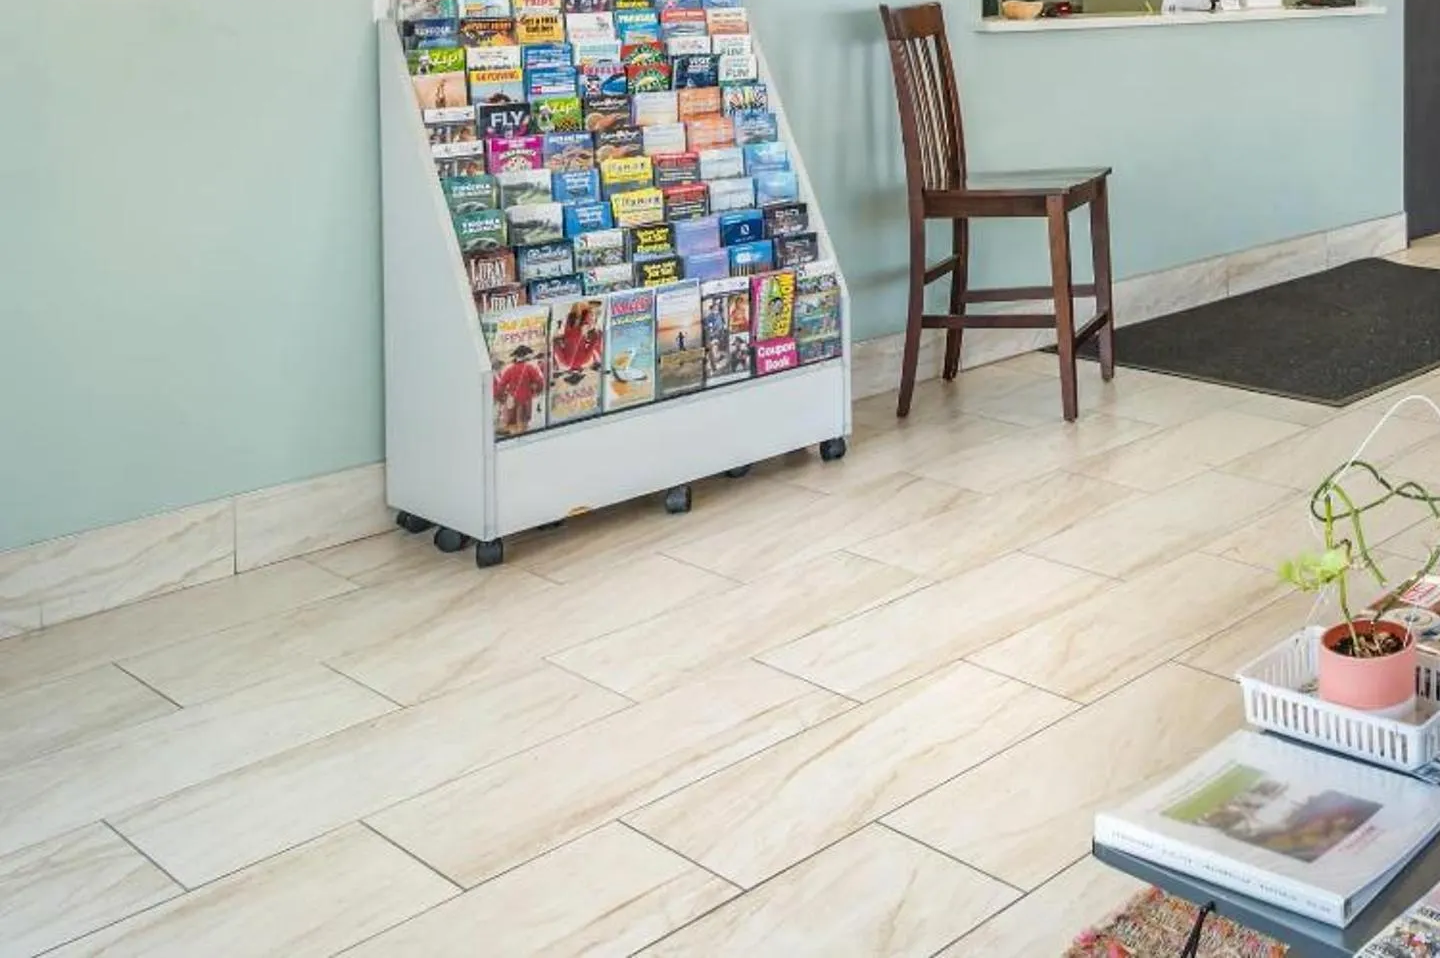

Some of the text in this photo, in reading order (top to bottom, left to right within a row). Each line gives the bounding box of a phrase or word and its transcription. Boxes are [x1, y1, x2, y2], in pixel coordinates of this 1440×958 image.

[490, 110, 524, 127] FLY
[757, 341, 796, 356] Coupon
[765, 357, 790, 372] Book
